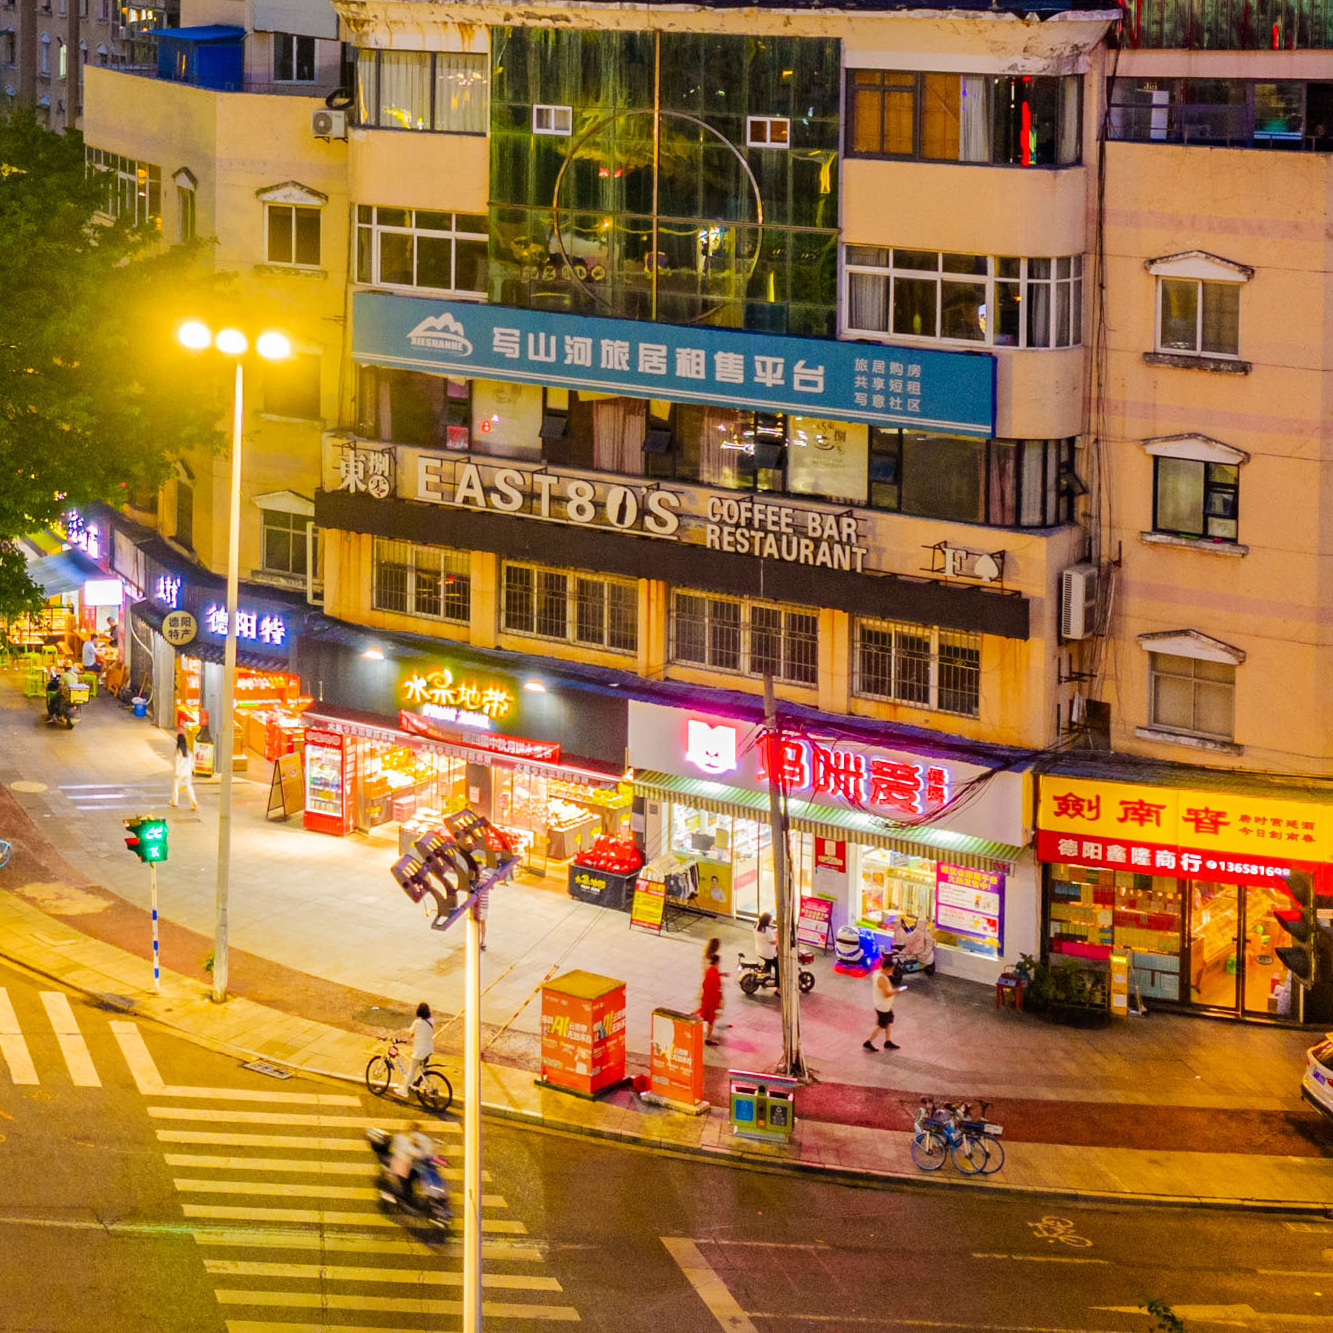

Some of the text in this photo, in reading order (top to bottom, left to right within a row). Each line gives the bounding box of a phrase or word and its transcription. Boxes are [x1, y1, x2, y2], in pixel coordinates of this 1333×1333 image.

[492, 326, 826, 394] 写山河旅居租售平台
[854, 358, 922, 378] 旅居购房
[854, 375, 922, 395] 共享短租
[854, 391, 922, 412] 写意社区
[707, 496, 859, 544] COFFEE BAR
[705, 523, 868, 573] RESTAURANT
[168, 629, 192, 640] 特产
[404, 669, 515, 718] 水果地带
[1058, 838, 1203, 873] 德阳鑫隆商行
